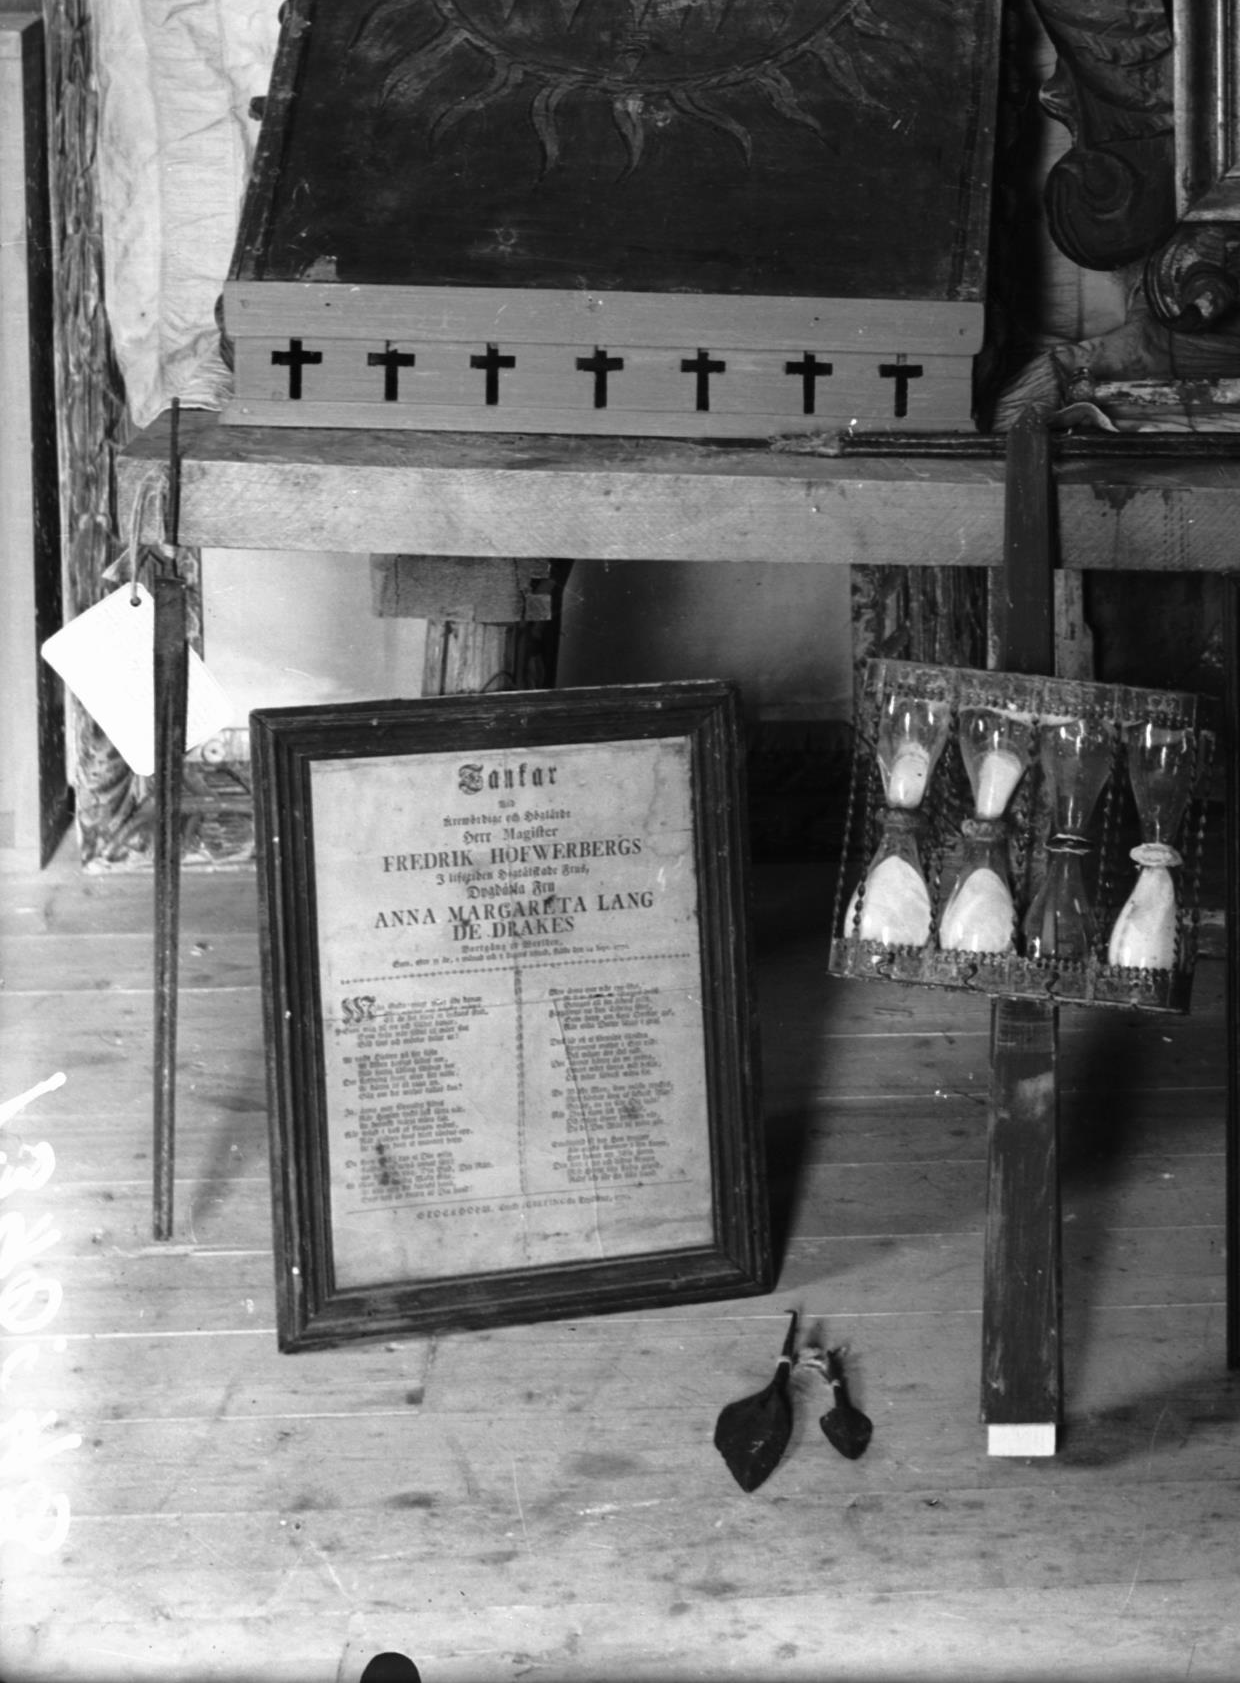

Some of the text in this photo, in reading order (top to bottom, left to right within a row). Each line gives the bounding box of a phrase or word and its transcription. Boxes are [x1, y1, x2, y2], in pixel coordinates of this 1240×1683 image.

[463, 831, 492, 845] Herr
[382, 837, 642, 873] FREDRIK HOFWERBERGS
[374, 890, 654, 929] ANNA MARGARETA LANG
[452, 916, 575, 941] DE DRAKES
